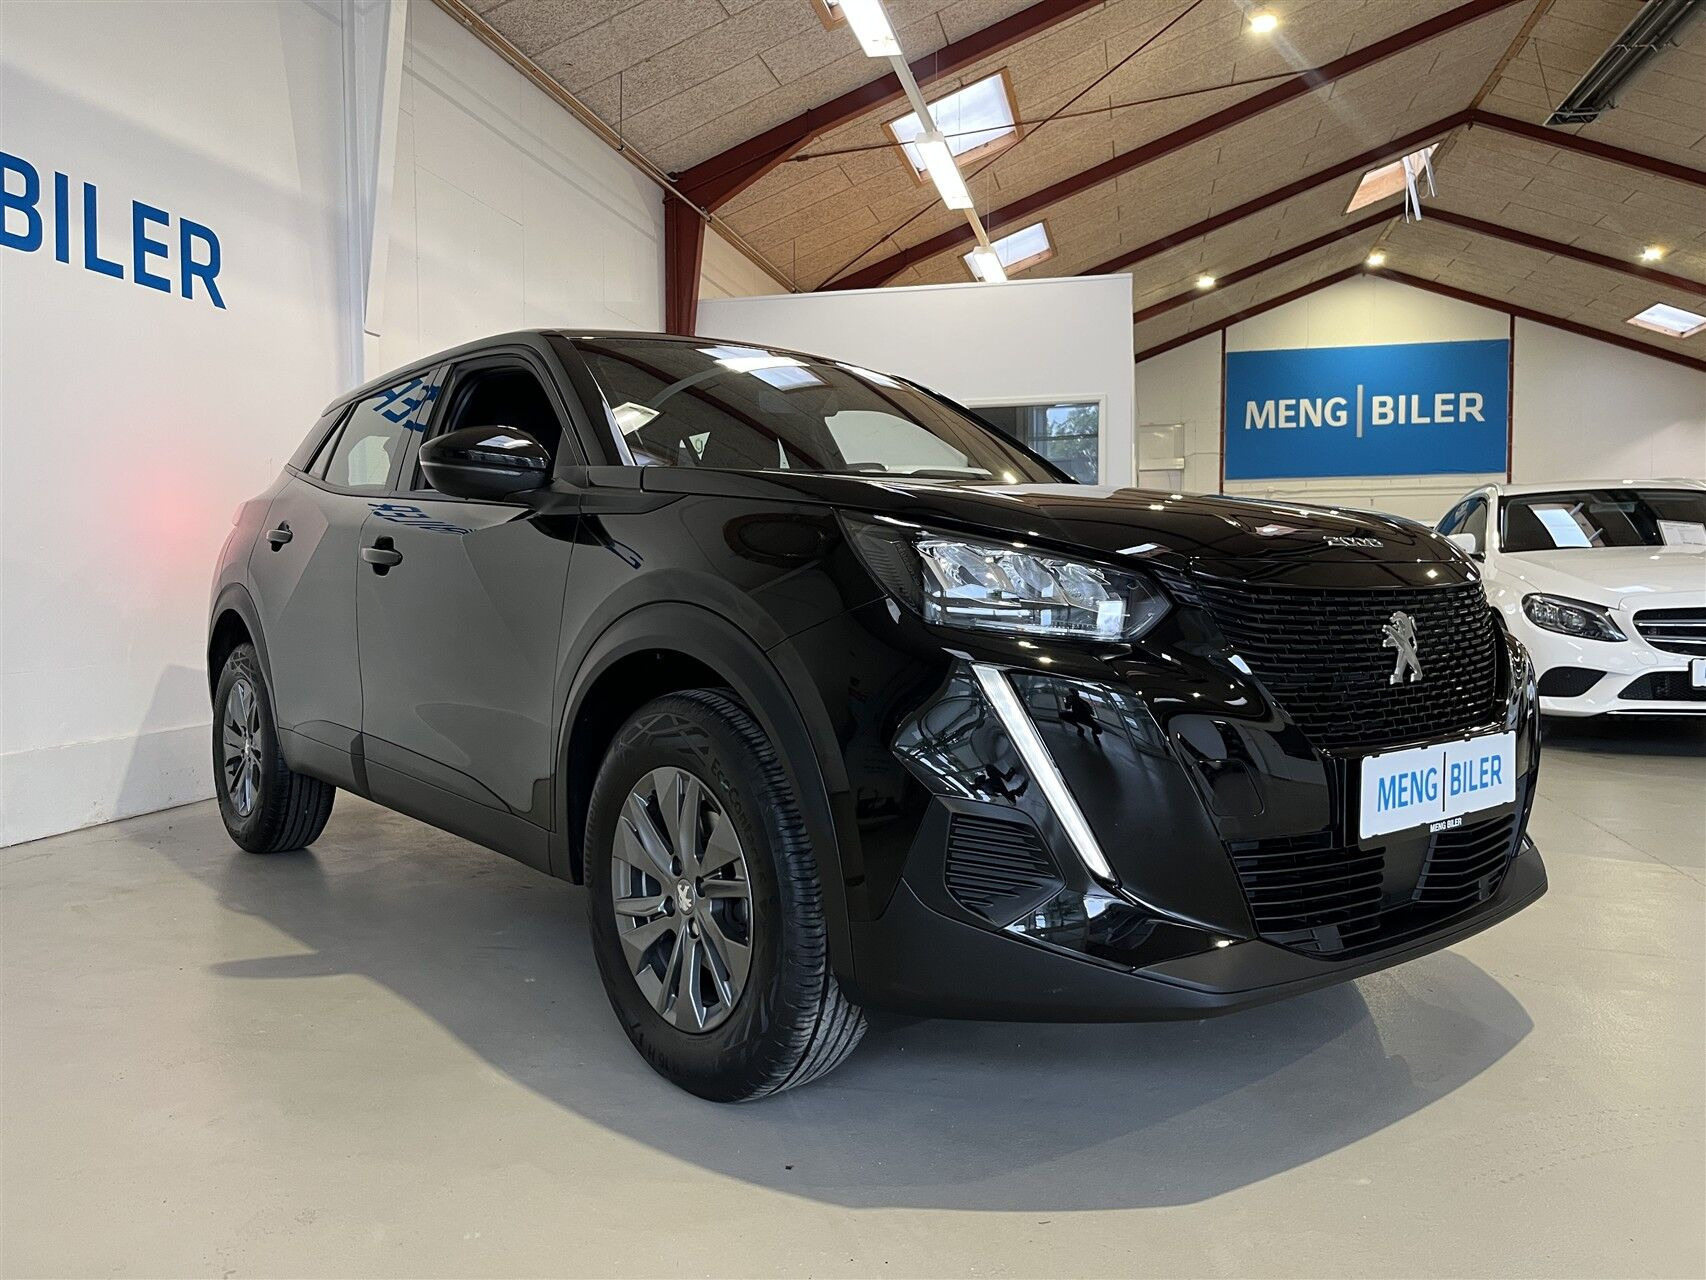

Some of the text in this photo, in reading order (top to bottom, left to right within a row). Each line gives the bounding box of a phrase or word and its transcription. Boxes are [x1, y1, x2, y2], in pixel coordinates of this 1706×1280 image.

[0, 151, 227, 310] BILER
[1244, 391, 1486, 430] MENG BILER
[1377, 754, 1502, 813] MENG BILER
[1430, 817, 1462, 833] MENG BILER
